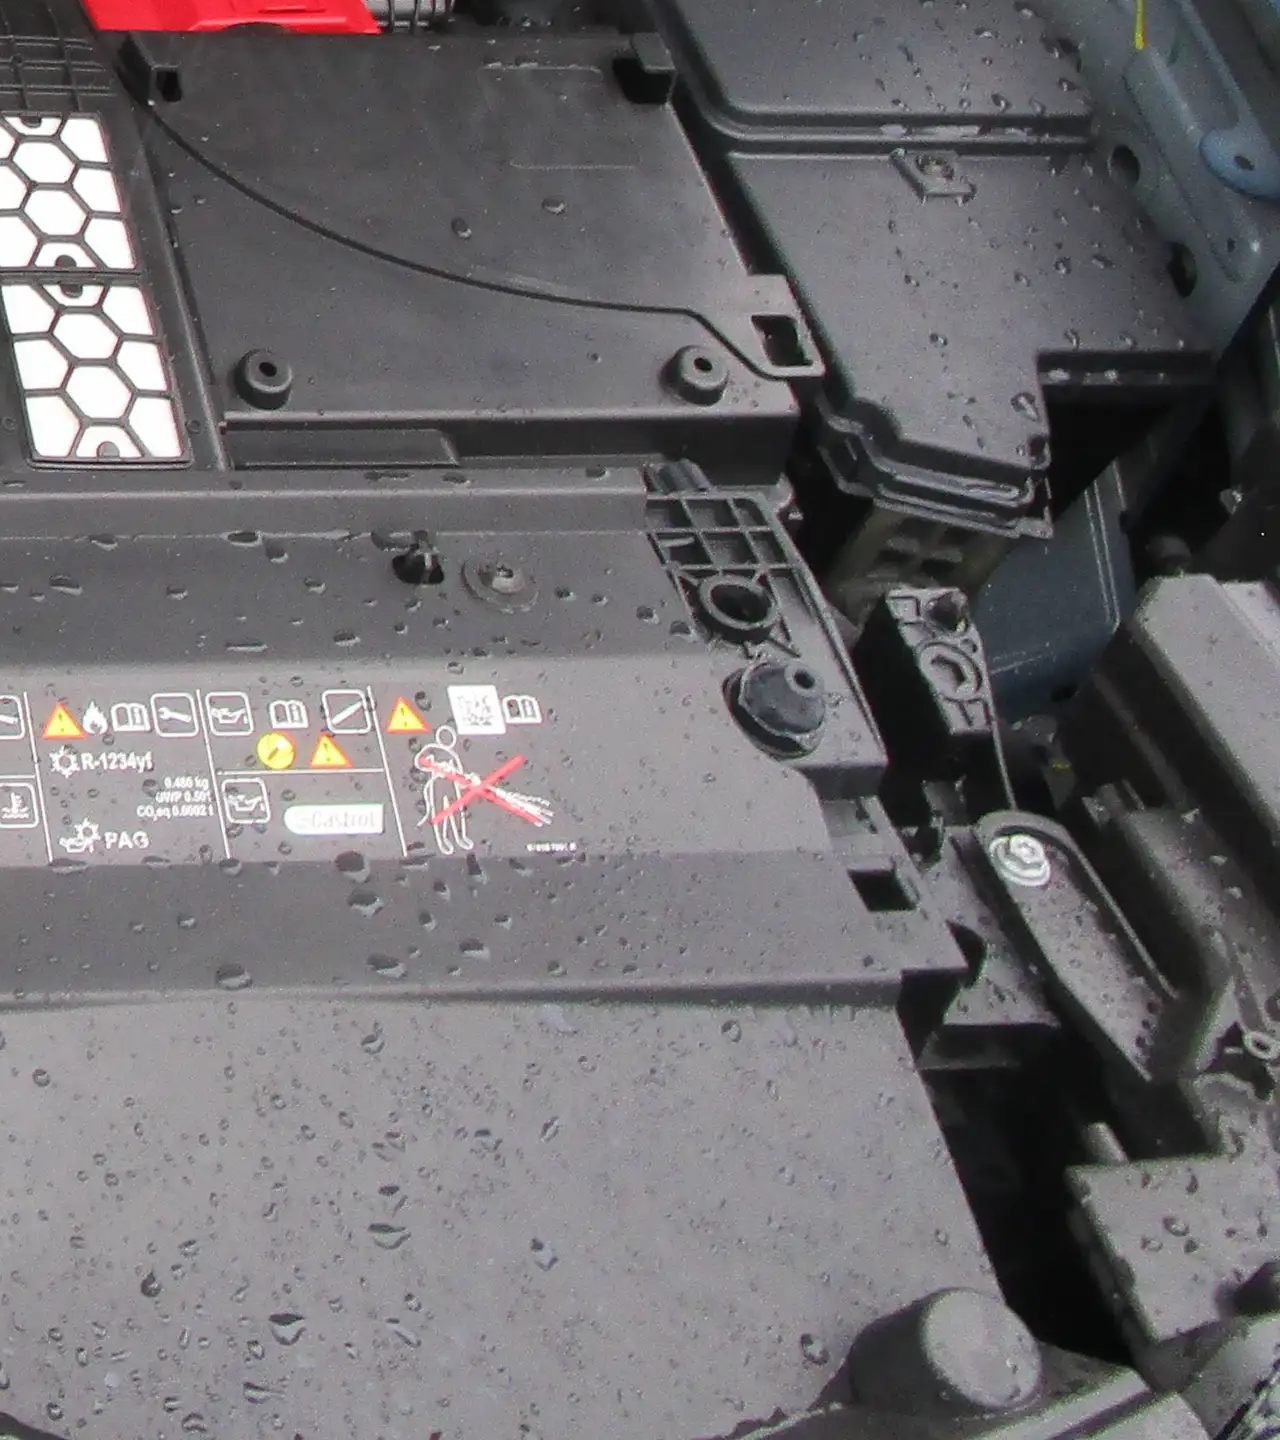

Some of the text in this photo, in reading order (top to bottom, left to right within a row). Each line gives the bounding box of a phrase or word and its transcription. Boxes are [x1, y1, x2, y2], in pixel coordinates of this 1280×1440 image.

[80, 751, 153, 773] R-1234yf
[312, 811, 376, 829] Castrol
[104, 831, 149, 849] PAG
